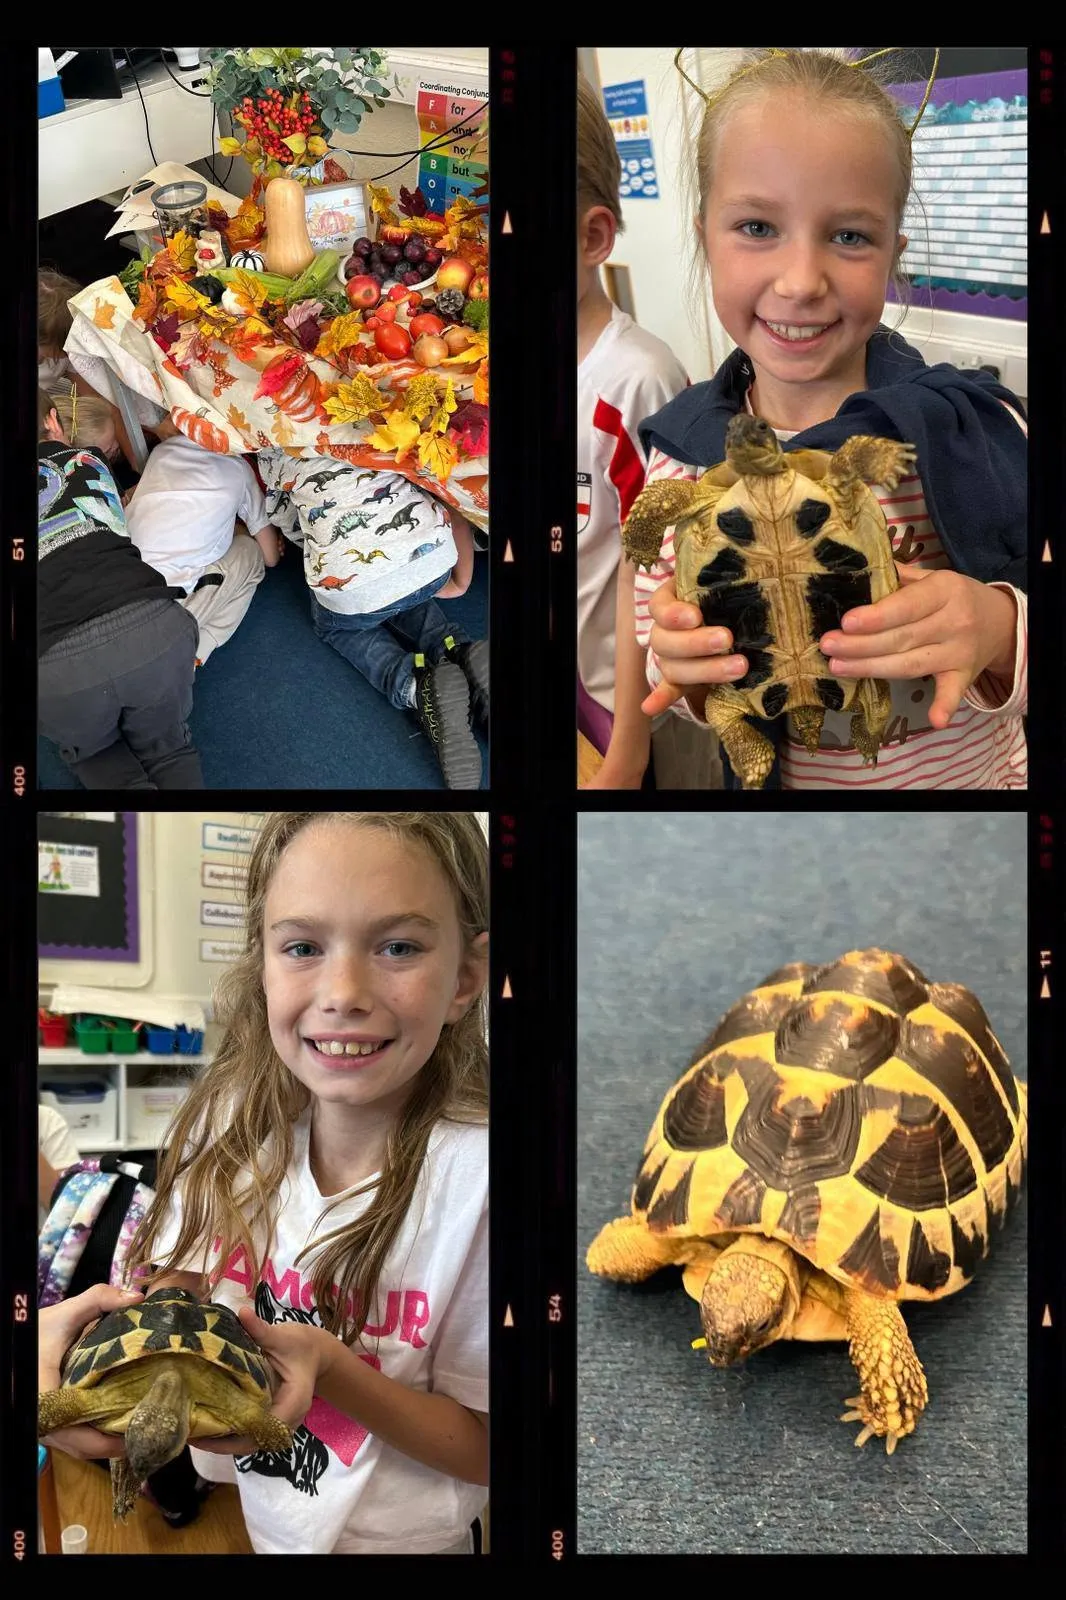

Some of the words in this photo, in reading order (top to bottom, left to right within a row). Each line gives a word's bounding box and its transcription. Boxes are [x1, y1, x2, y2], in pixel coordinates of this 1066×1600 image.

[419, 82, 461, 96] Coordinating
[428, 99, 436, 110] F
[451, 102, 466, 115] for
[430, 120, 437, 130] A
[430, 159, 437, 169] B
[452, 164, 470, 176] but
[428, 179, 436, 189] O
[450, 186, 461, 194] or
[428, 198, 435, 207] Y
